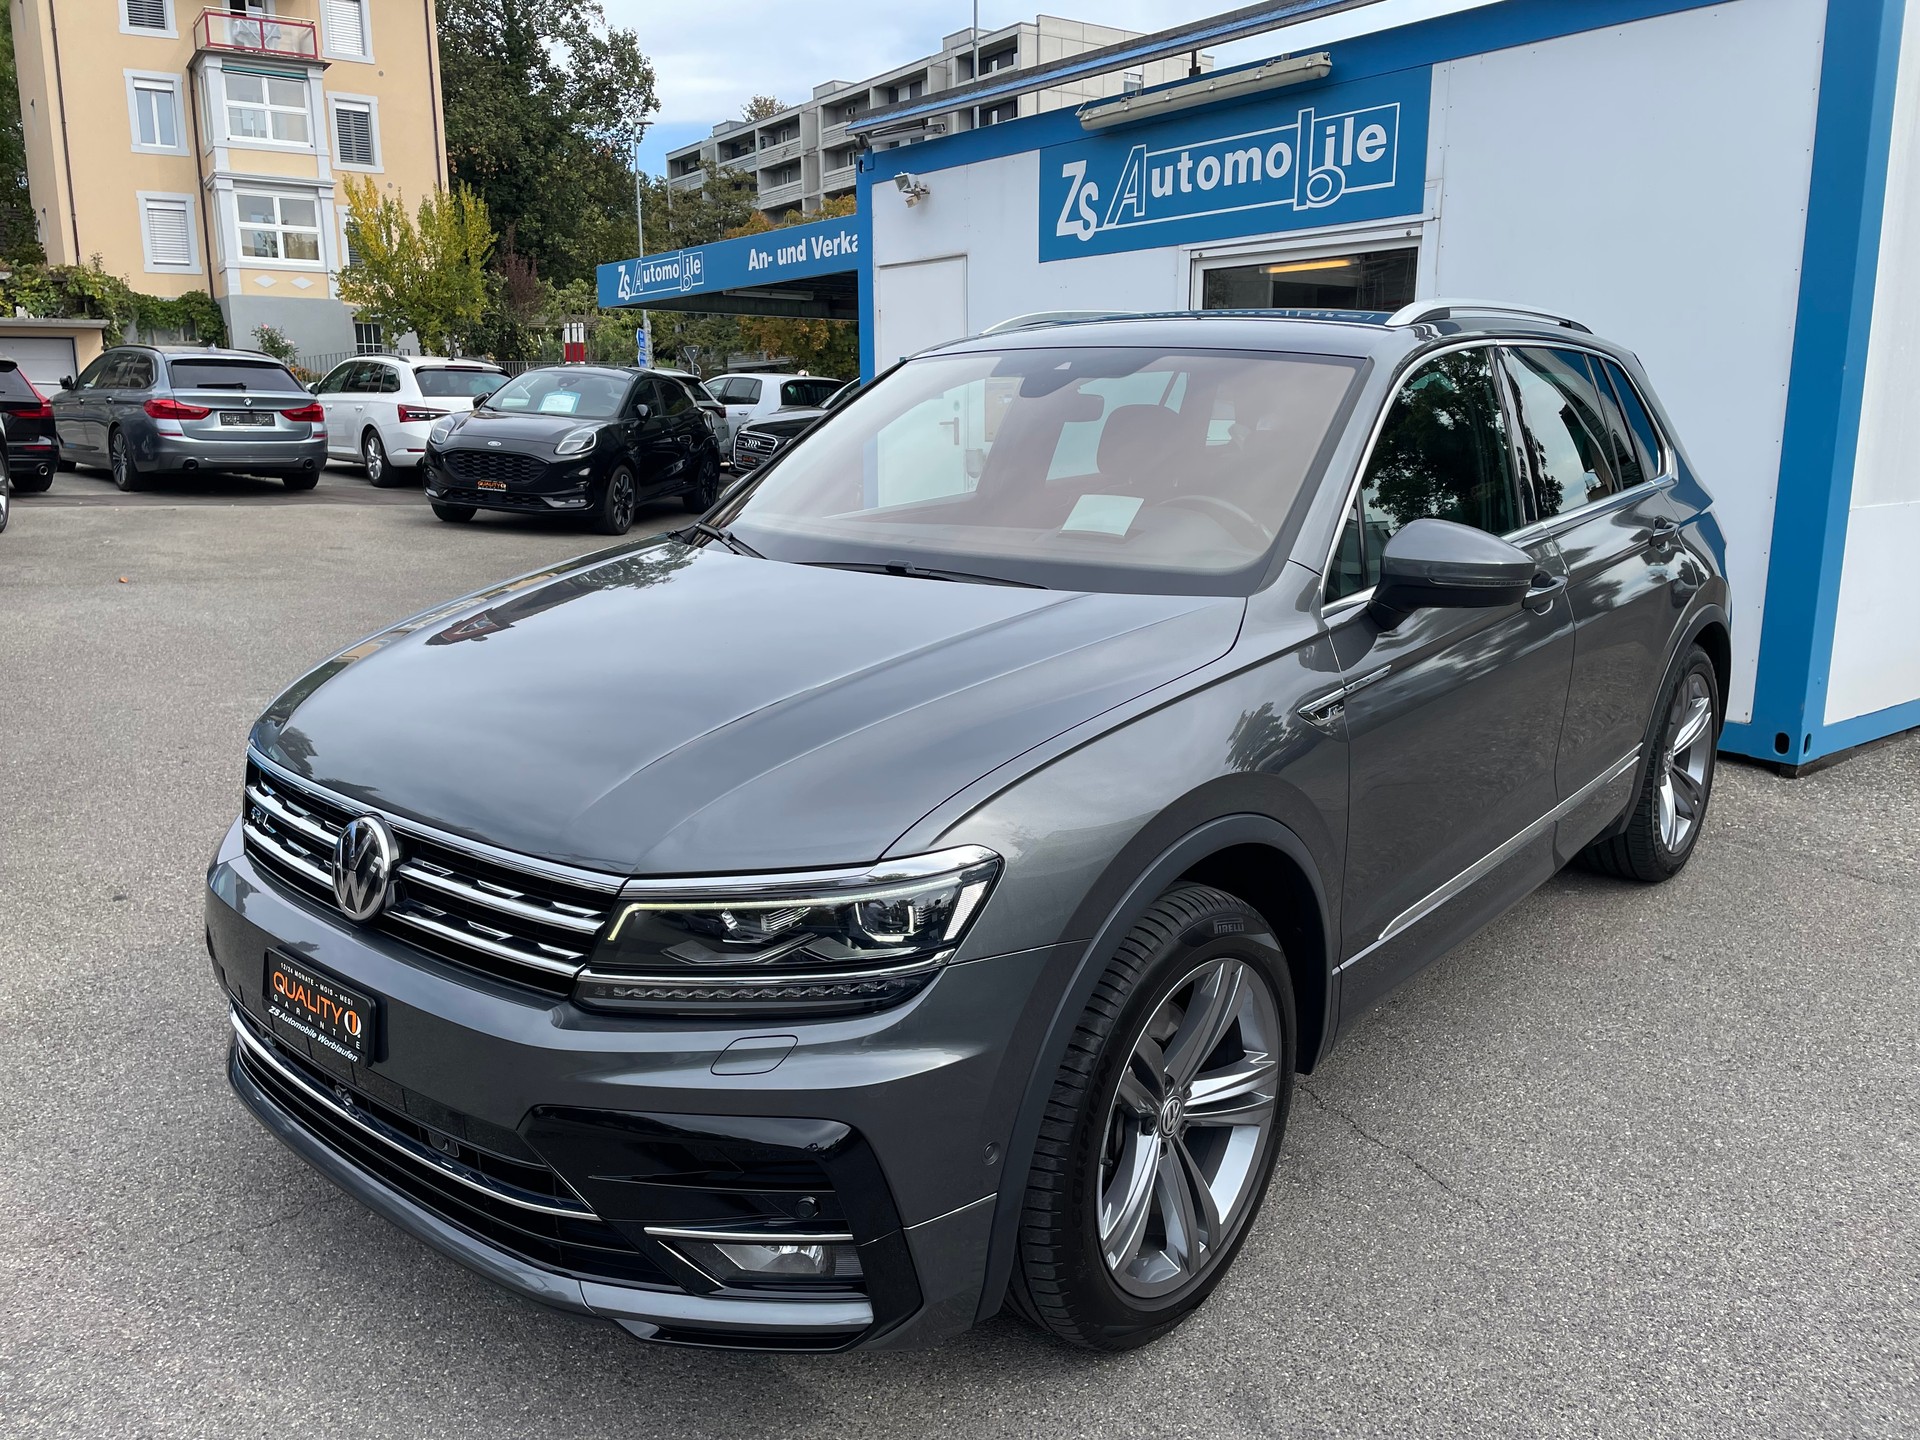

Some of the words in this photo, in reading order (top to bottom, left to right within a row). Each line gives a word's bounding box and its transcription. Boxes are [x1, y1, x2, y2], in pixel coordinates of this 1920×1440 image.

[1103, 107, 1387, 228] Automobile
[632, 251, 701, 295] Automobile
[748, 248, 773, 271] An-
[777, 238, 807, 266] und
[1213, 918, 1245, 934] PIRELLI
[273, 971, 343, 1025] QUALITY
[294, 969, 314, 986] MONATE
[320, 984, 333, 996] MOIS
[340, 994, 353, 1006] MESI
[268, 1006, 280, 1016] ZS
[279, 1012, 317, 1039] Automobile
[317, 1033, 359, 1062] Worblaufen
